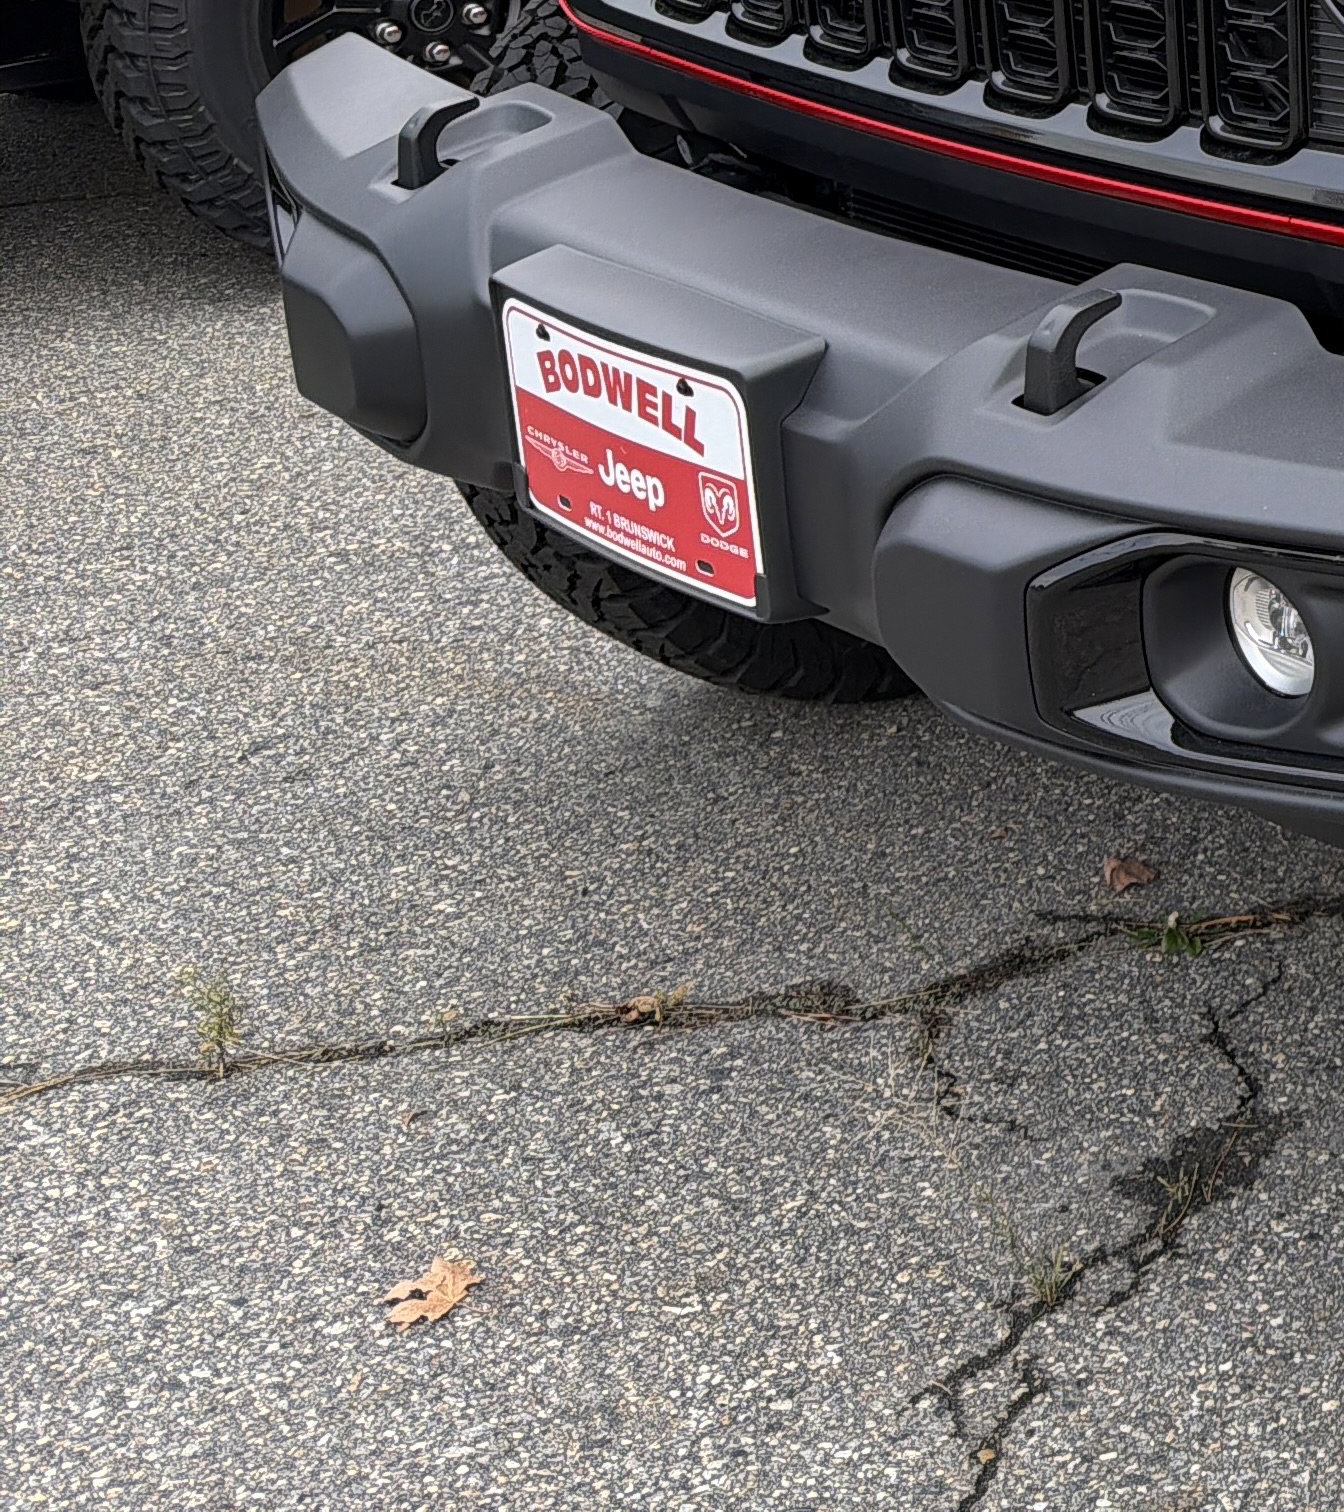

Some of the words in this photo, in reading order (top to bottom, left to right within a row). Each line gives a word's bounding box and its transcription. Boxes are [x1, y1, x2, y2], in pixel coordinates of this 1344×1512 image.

[536, 349, 705, 458] BODWELL
[526, 425, 589, 465] CHRYSLER
[598, 449, 665, 511] Jeep
[584, 517, 687, 572] www.bodwellauto.com
[589, 501, 605, 523] RT.
[612, 511, 676, 552] BRUNSWICK
[700, 532, 749, 559] DODGE
